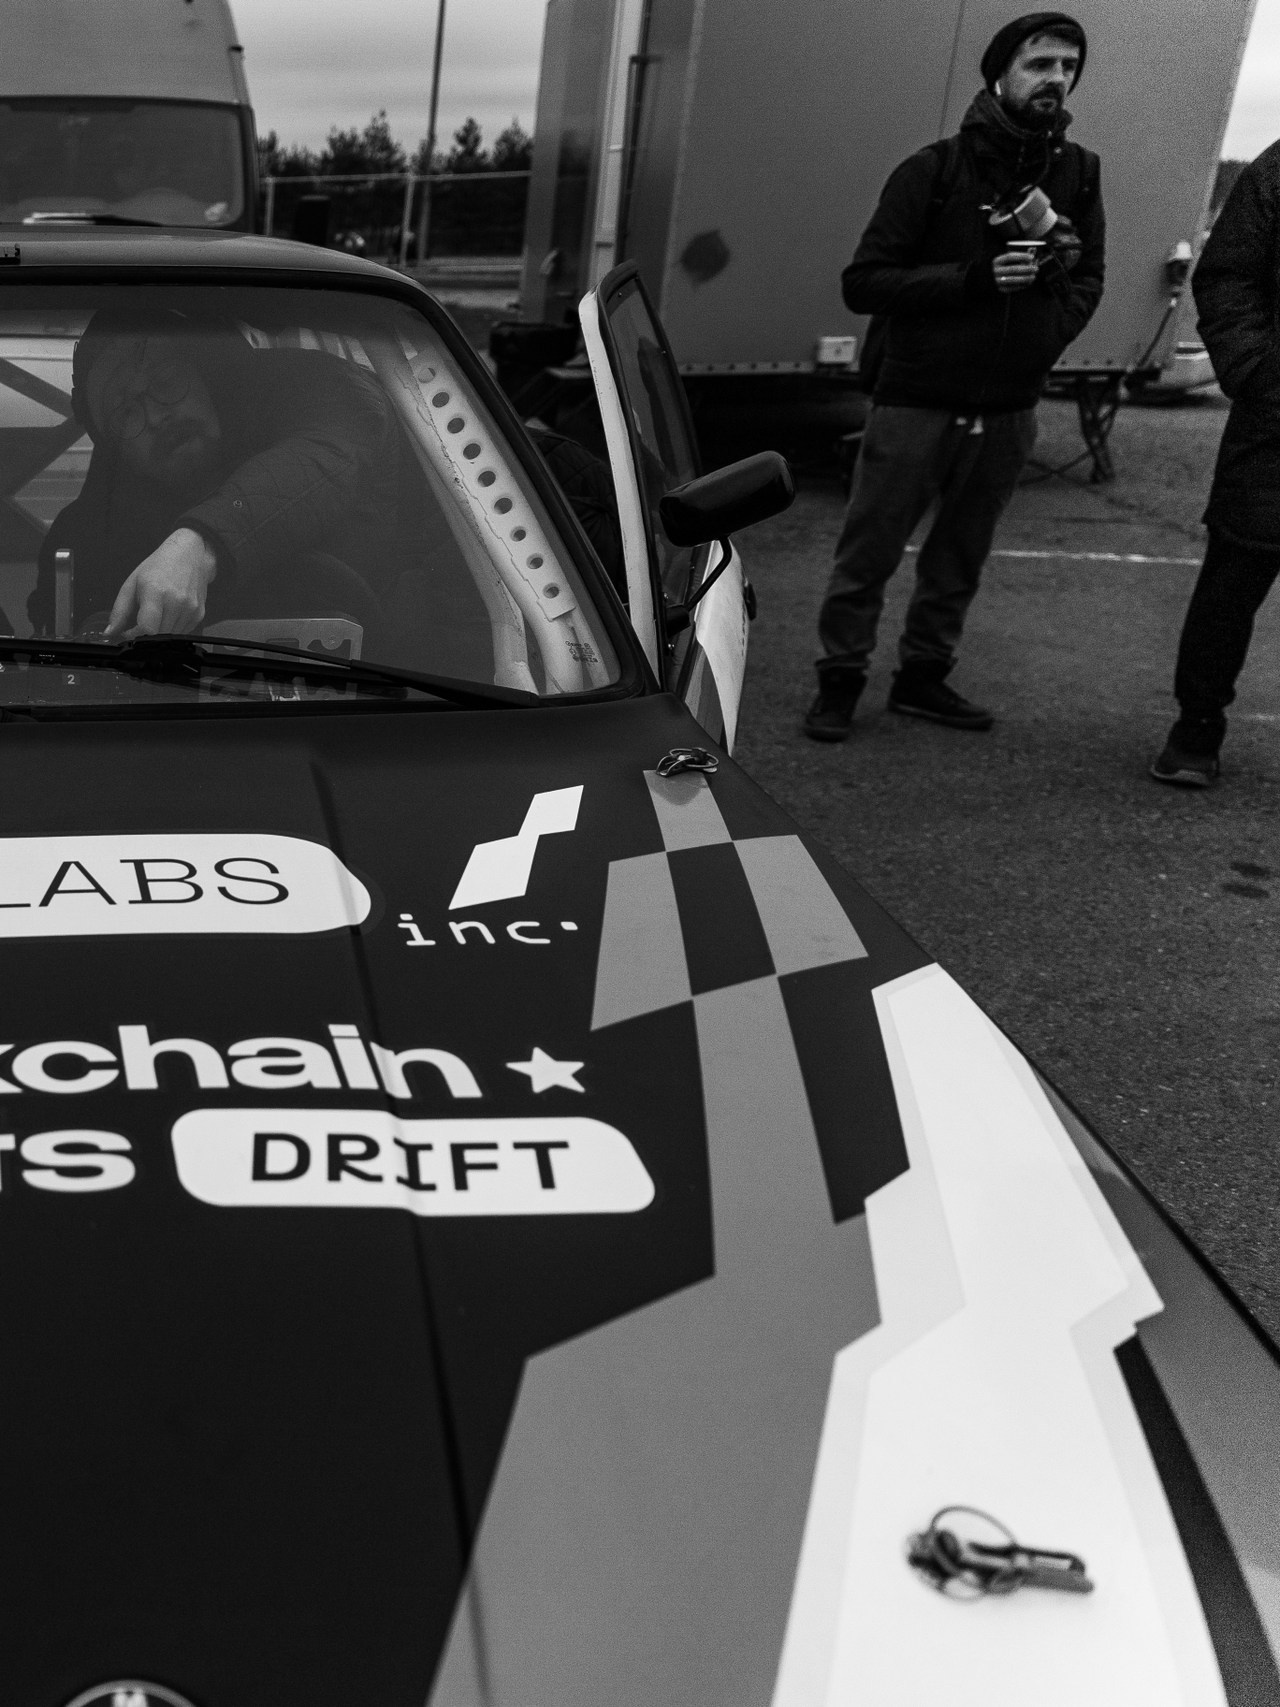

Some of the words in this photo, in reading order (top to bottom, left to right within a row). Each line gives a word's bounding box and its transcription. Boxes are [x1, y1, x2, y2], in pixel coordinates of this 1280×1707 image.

[67, 674, 76, 685] 2
[398, 913, 579, 947] inc.
[251, 1132, 570, 1192] DRIFT
